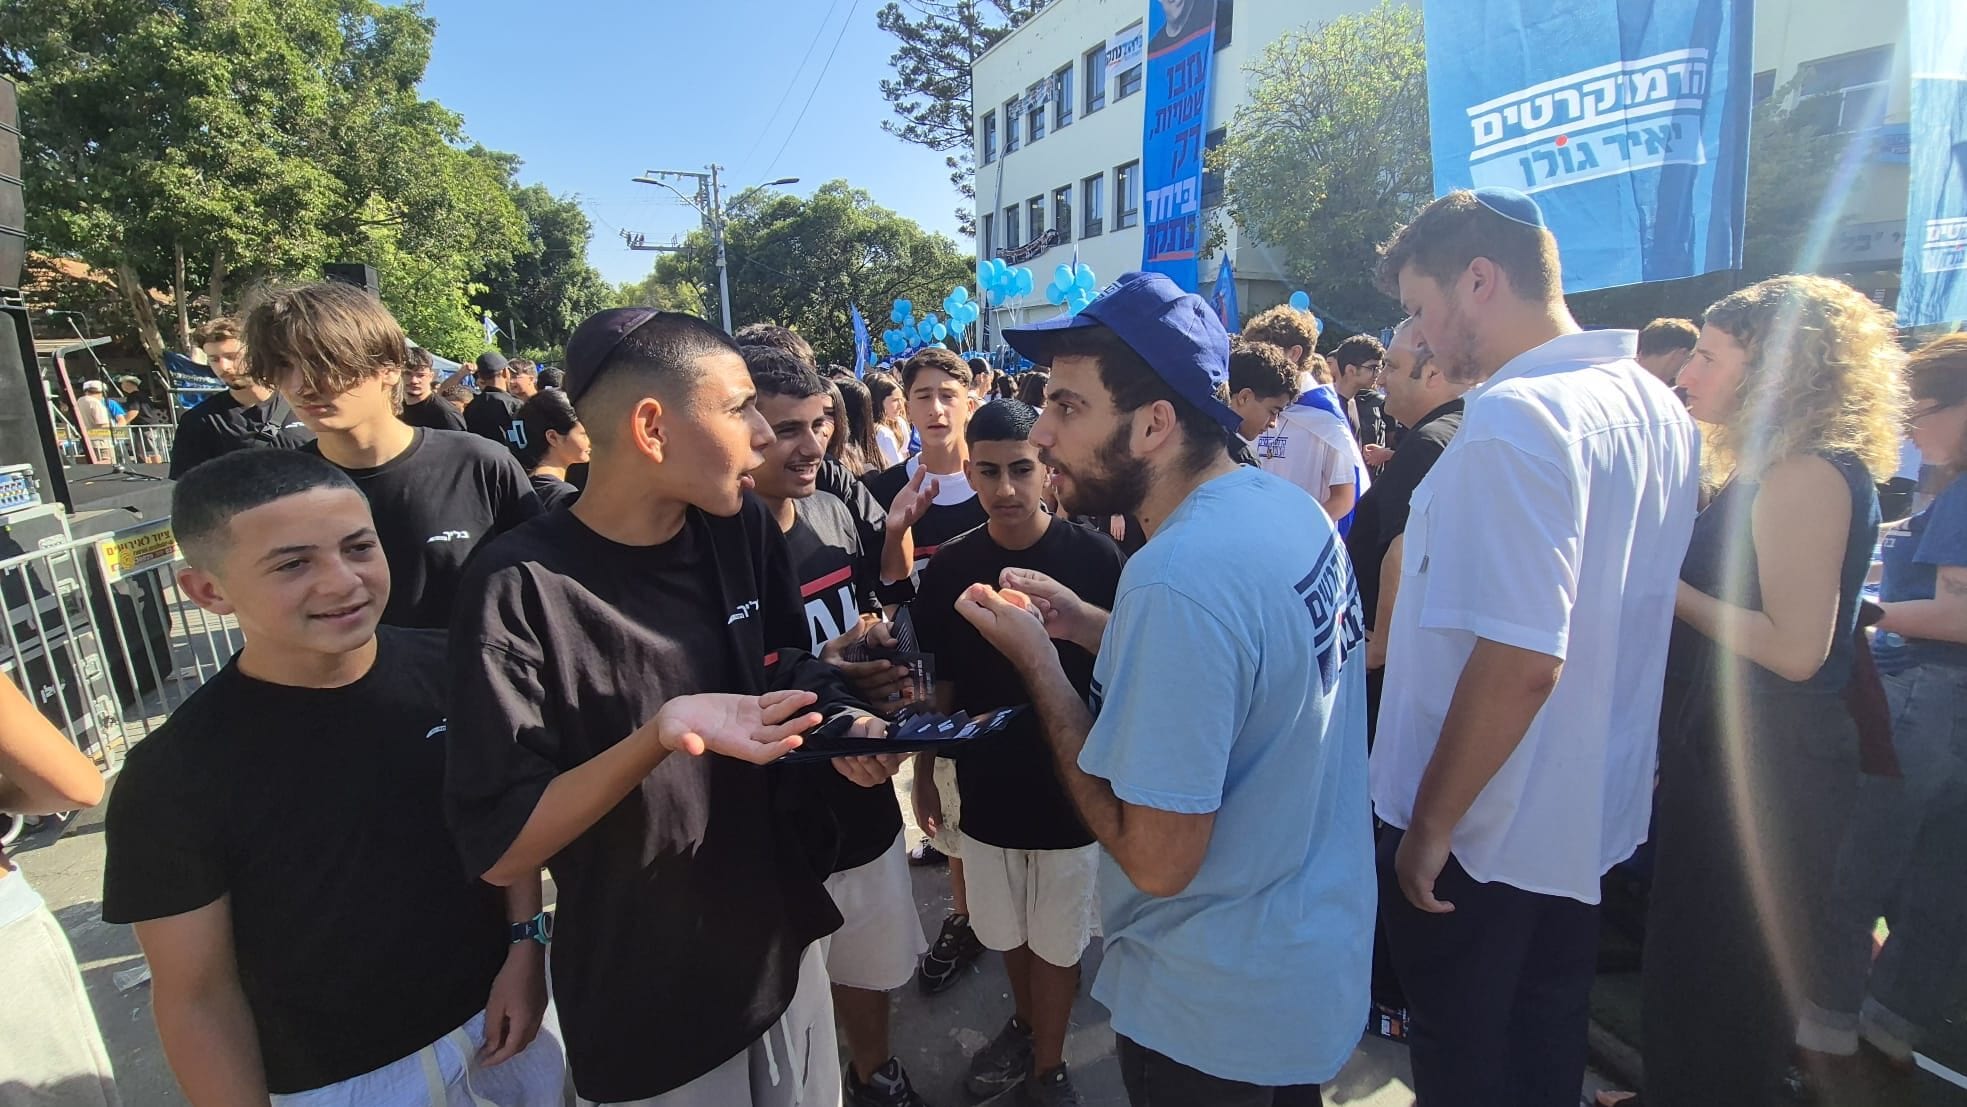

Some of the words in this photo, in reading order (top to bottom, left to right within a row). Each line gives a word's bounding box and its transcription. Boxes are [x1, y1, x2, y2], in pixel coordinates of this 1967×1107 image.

[1471, 62, 1707, 147] הדמוקרטים
[1171, 124, 1200, 178] רק
[1519, 135, 1600, 187] גולן
[1602, 122, 1682, 161] יאיר
